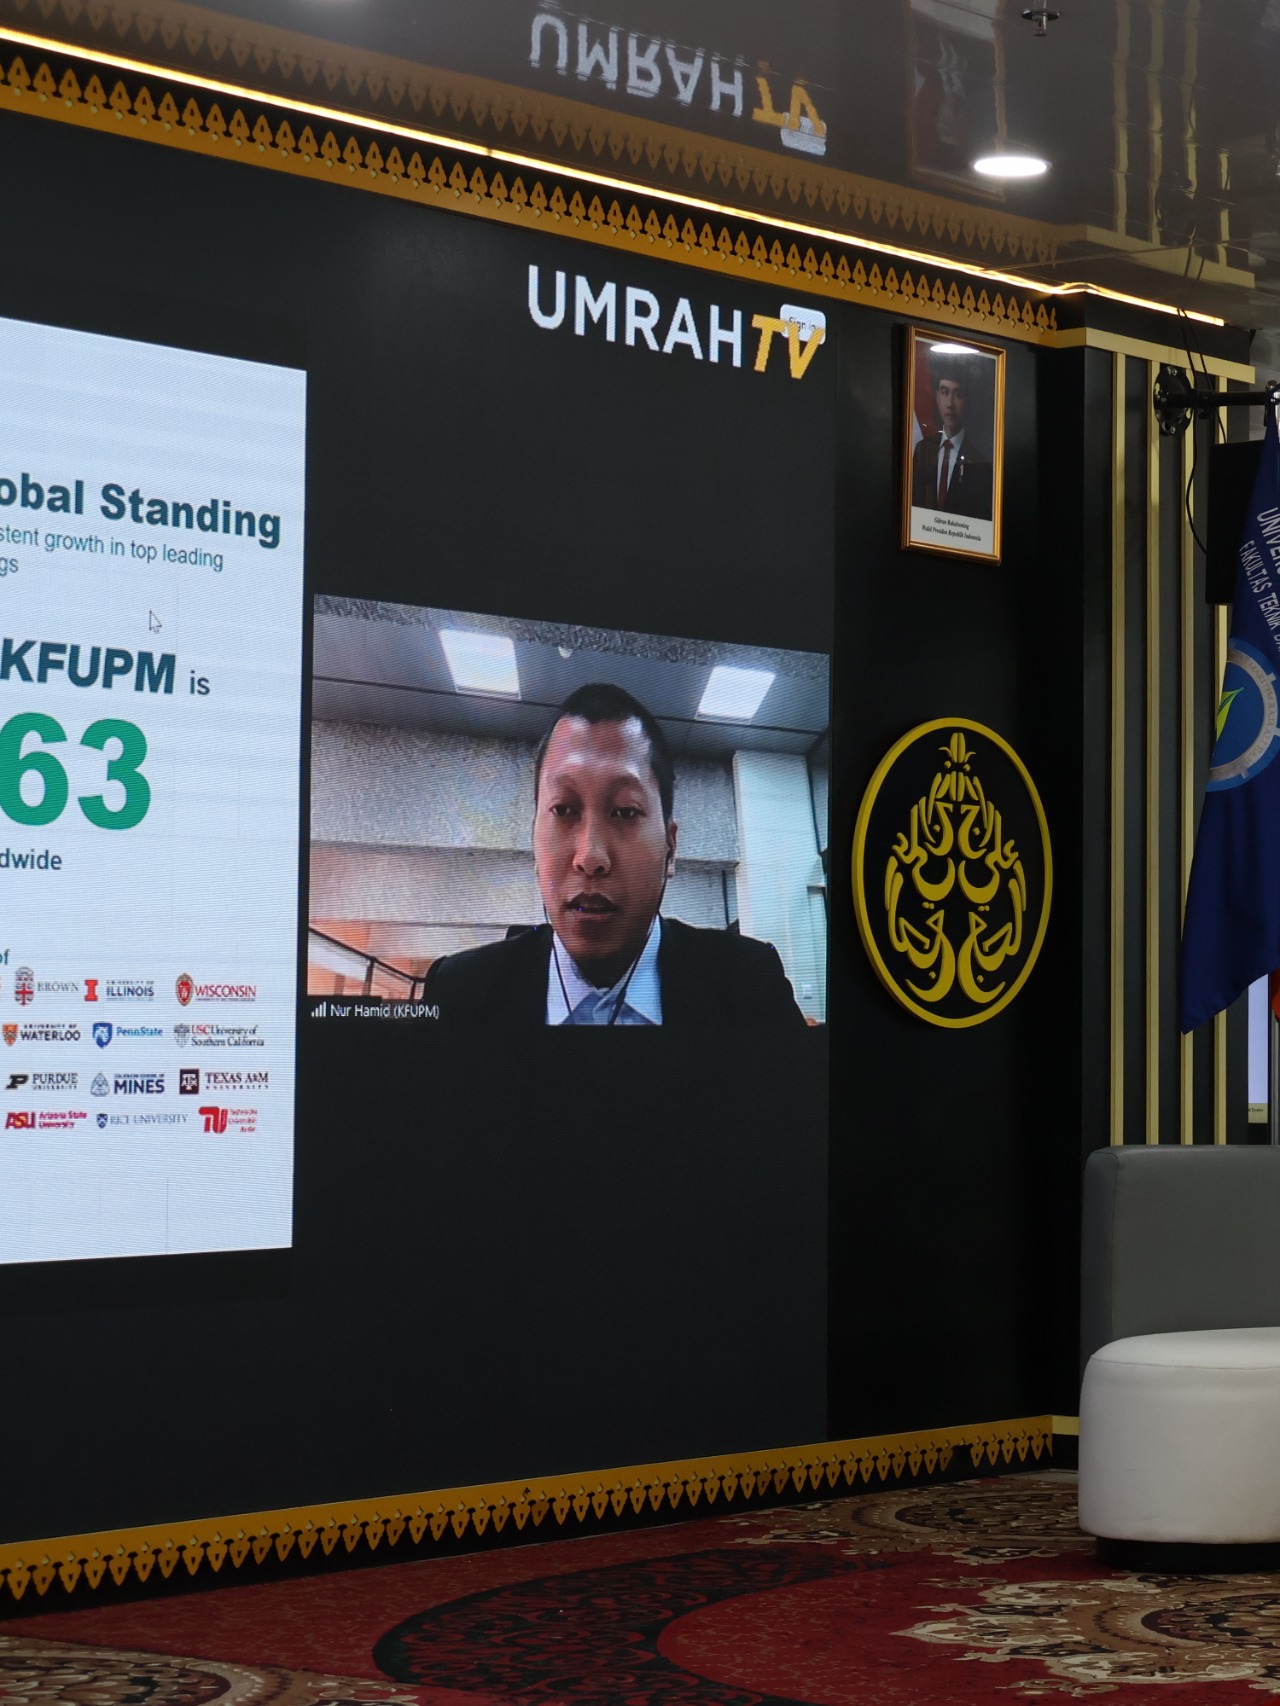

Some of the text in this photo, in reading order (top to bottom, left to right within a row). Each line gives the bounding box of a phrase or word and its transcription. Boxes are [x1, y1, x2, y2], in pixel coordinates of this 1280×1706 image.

[100, 482, 281, 549] Standing
[45, 532, 104, 556] growth
[110, 537, 125, 555] in
[130, 541, 158, 563] top
[162, 543, 224, 572] leading
[1239, 540, 1273, 594] FAKULTAS
[0, 637, 210, 696] KFUPM is
[0, 712, 152, 830] 63
[106, 986, 155, 997] ILLINOIS
[195, 985, 256, 998] WISCONSIN
[330, 1004, 440, 1020] Nur Hamid (KFUPM)
[20, 1030, 81, 1041] WATERLOO
[32, 1073, 78, 1084] PURDUE
[205, 1072, 242, 1084] TEXAS
[114, 1080, 165, 1094] MINES
